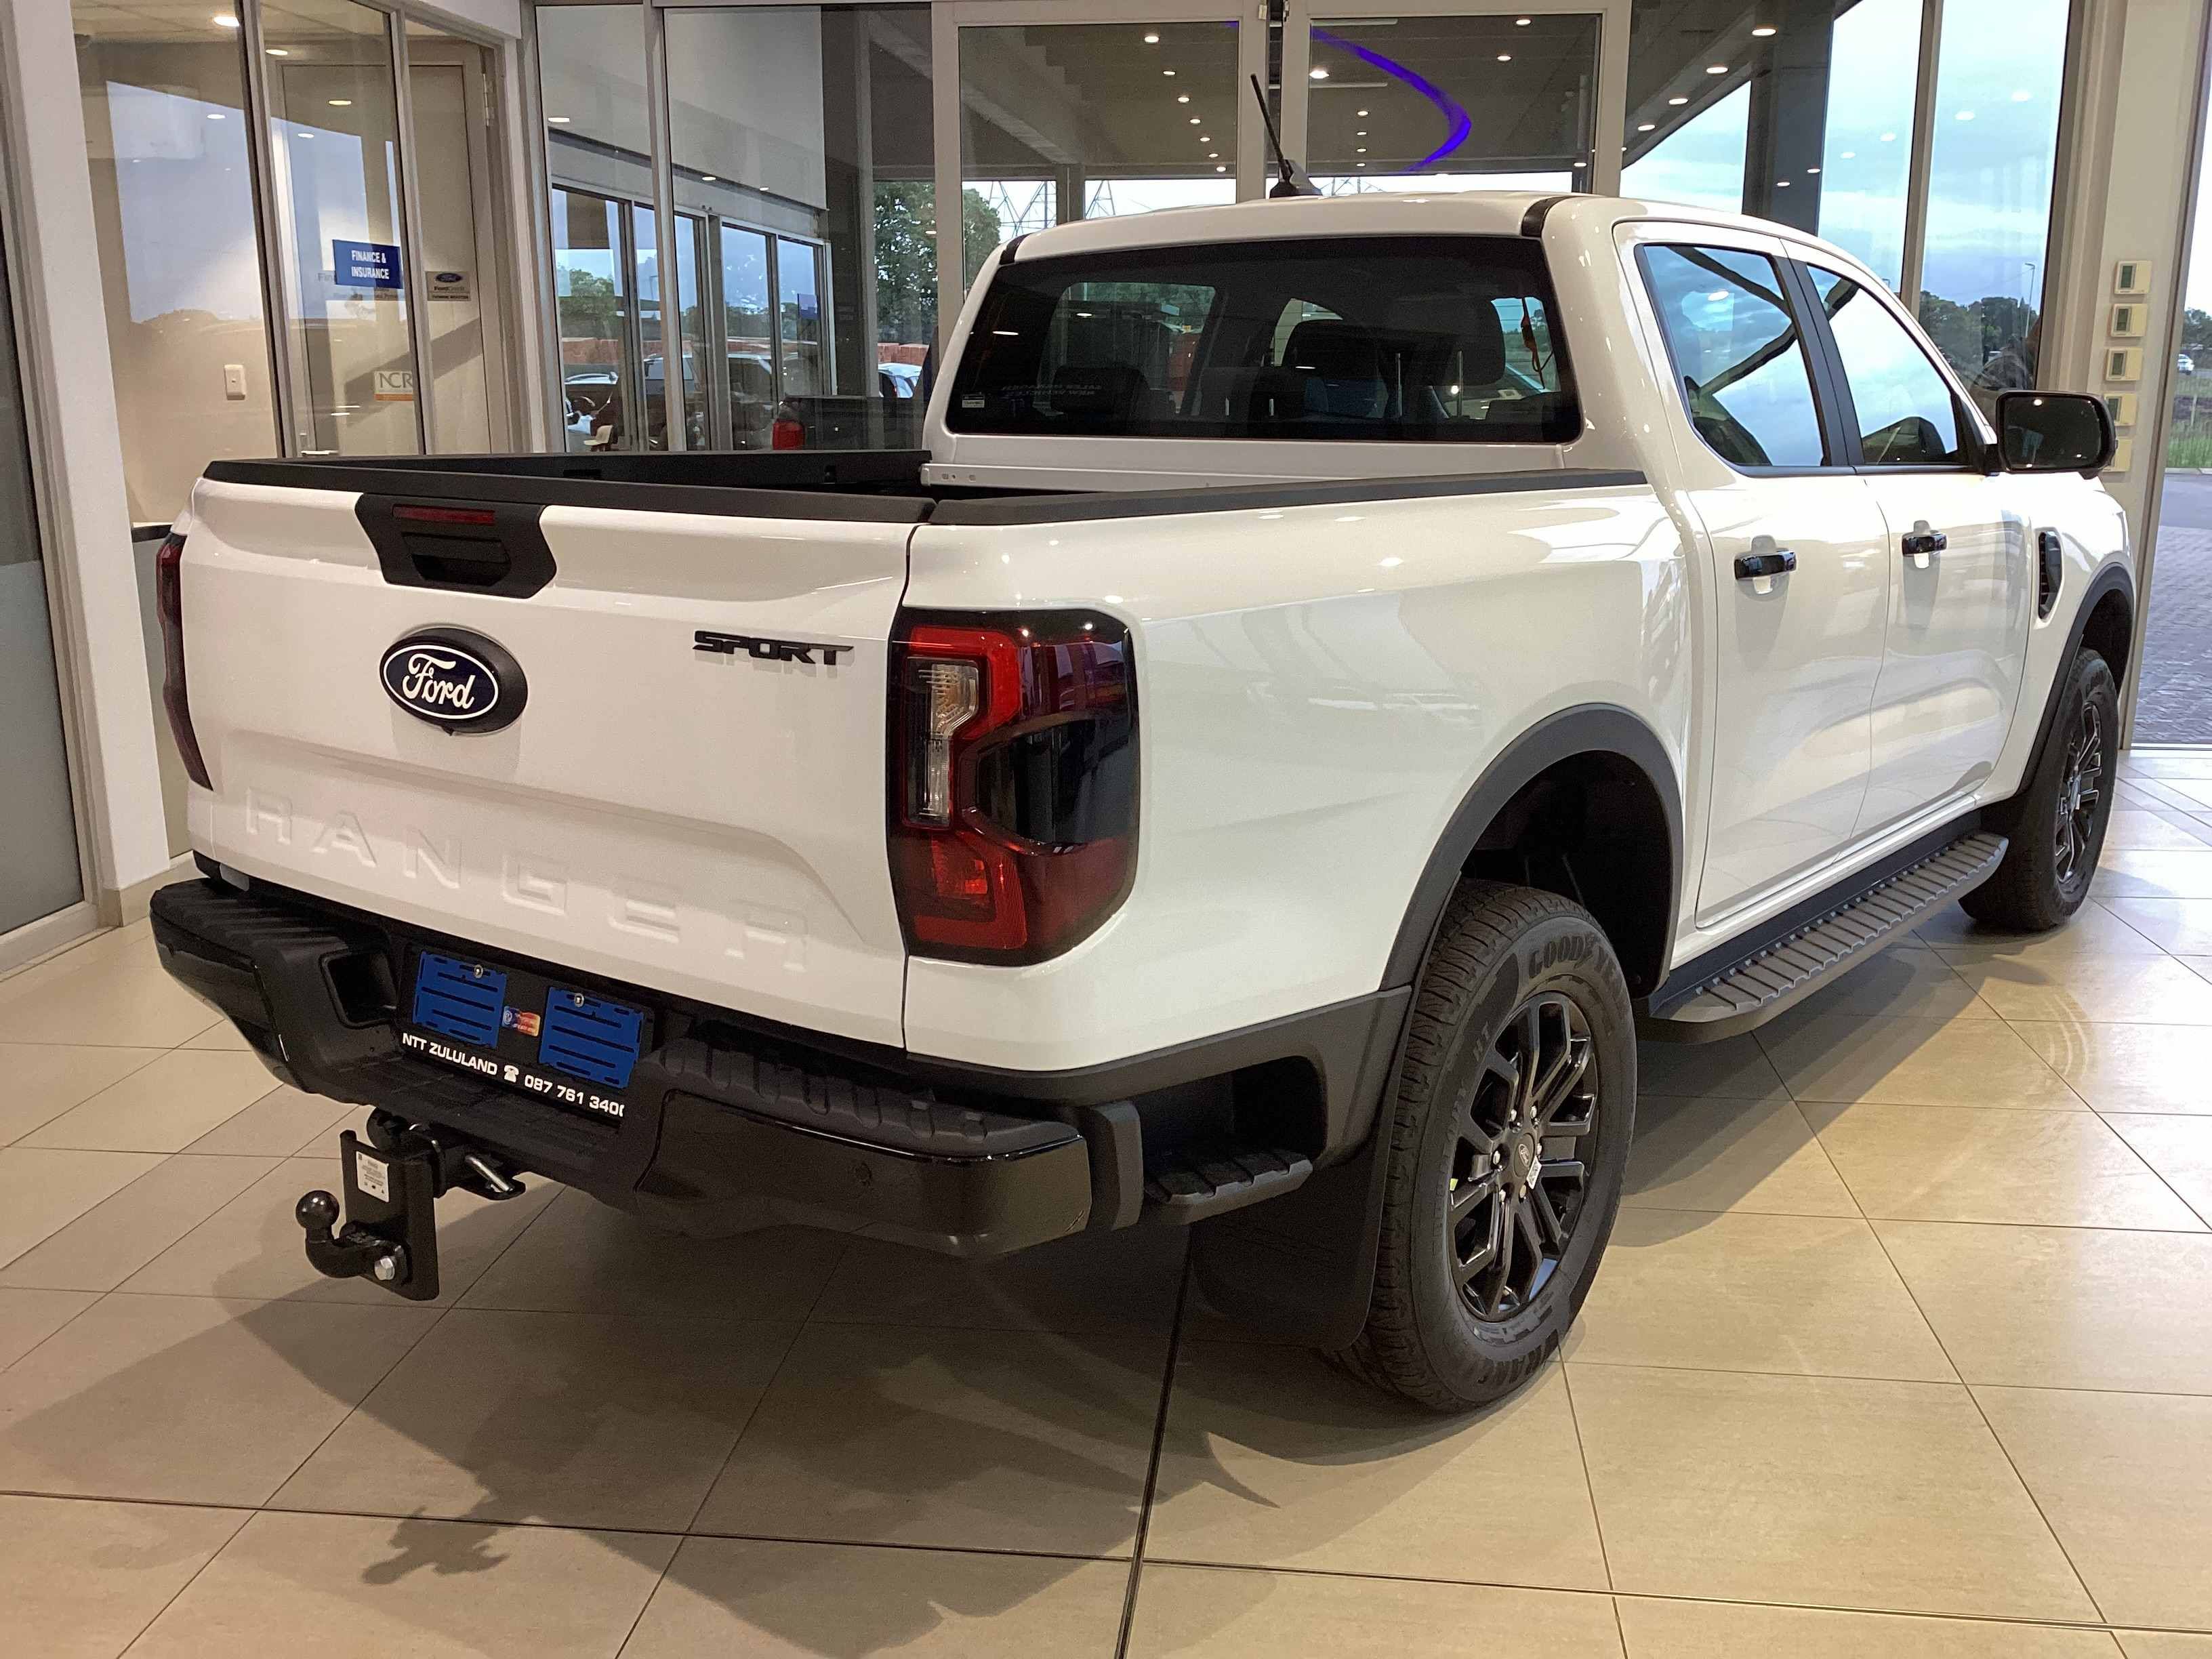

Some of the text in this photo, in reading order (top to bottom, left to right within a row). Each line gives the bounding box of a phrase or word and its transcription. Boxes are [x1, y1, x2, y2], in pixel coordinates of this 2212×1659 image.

[351, 249, 387, 264] FINANCE &
[351, 266, 390, 280] INSURANCE
[379, 372, 413, 388] NCR
[693, 630, 854, 665] SPORT
[402, 653, 476, 709] Ford
[243, 786, 808, 973] RANGER
[402, 1033, 427, 1050] NTT
[429, 1042, 497, 1076] ZULULAND
[524, 1074, 553, 1094] 087
[556, 1085, 583, 1104] 761
